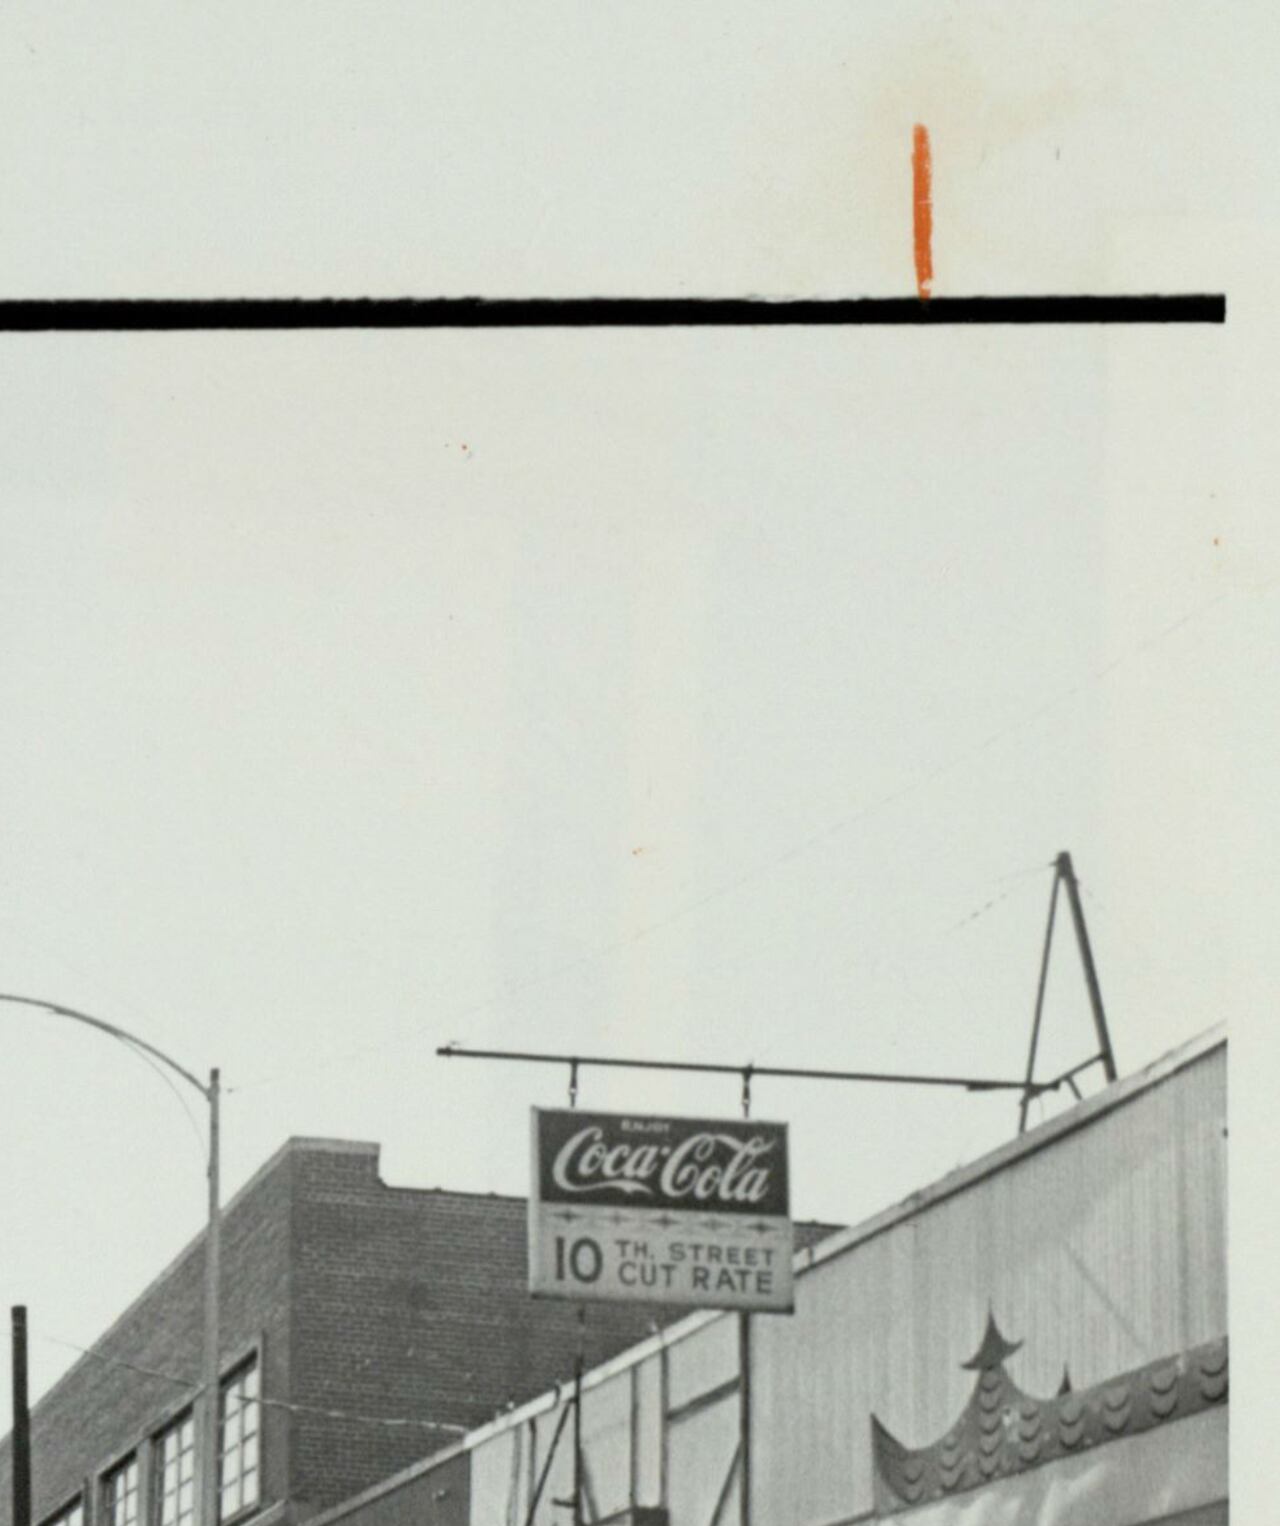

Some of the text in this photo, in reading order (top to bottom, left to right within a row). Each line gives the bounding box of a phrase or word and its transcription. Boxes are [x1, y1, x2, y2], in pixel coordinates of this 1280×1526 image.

[553, 1126, 776, 1203] Coca-Cola
[556, 1236, 603, 1283] 10
[669, 1242, 774, 1267] STREET
[618, 1261, 773, 1294] CUT RATE
